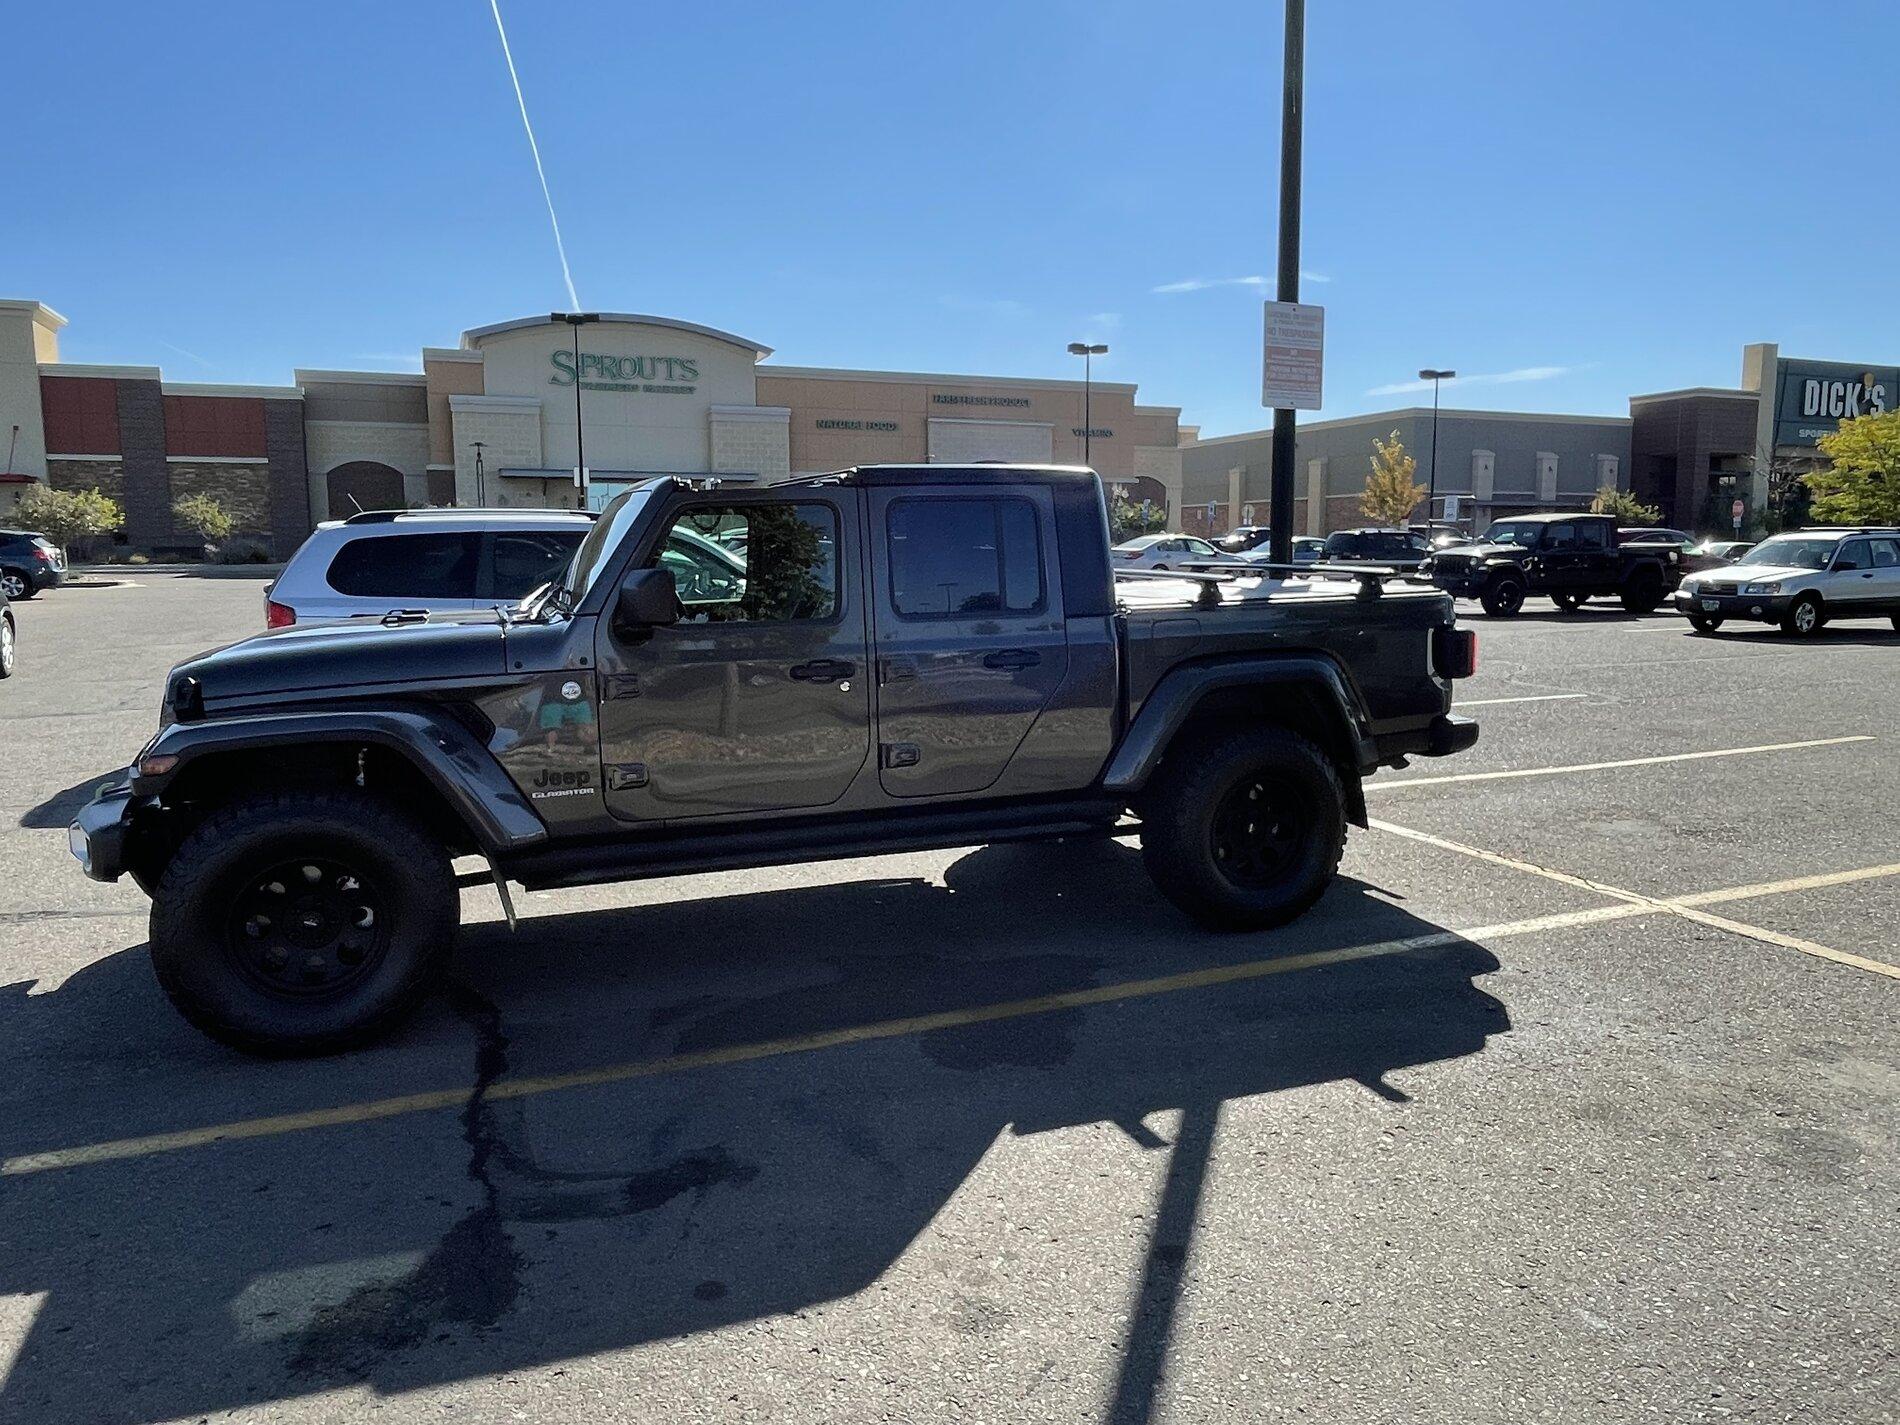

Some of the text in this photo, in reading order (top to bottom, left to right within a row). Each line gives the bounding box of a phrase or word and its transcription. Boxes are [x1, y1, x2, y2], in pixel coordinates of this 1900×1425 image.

[549, 350, 699, 386] SPROUTS
[1804, 380, 1885, 419] DICK'S
[533, 769, 591, 787] Jeep
[532, 788, 595, 799] GLADIATOR
